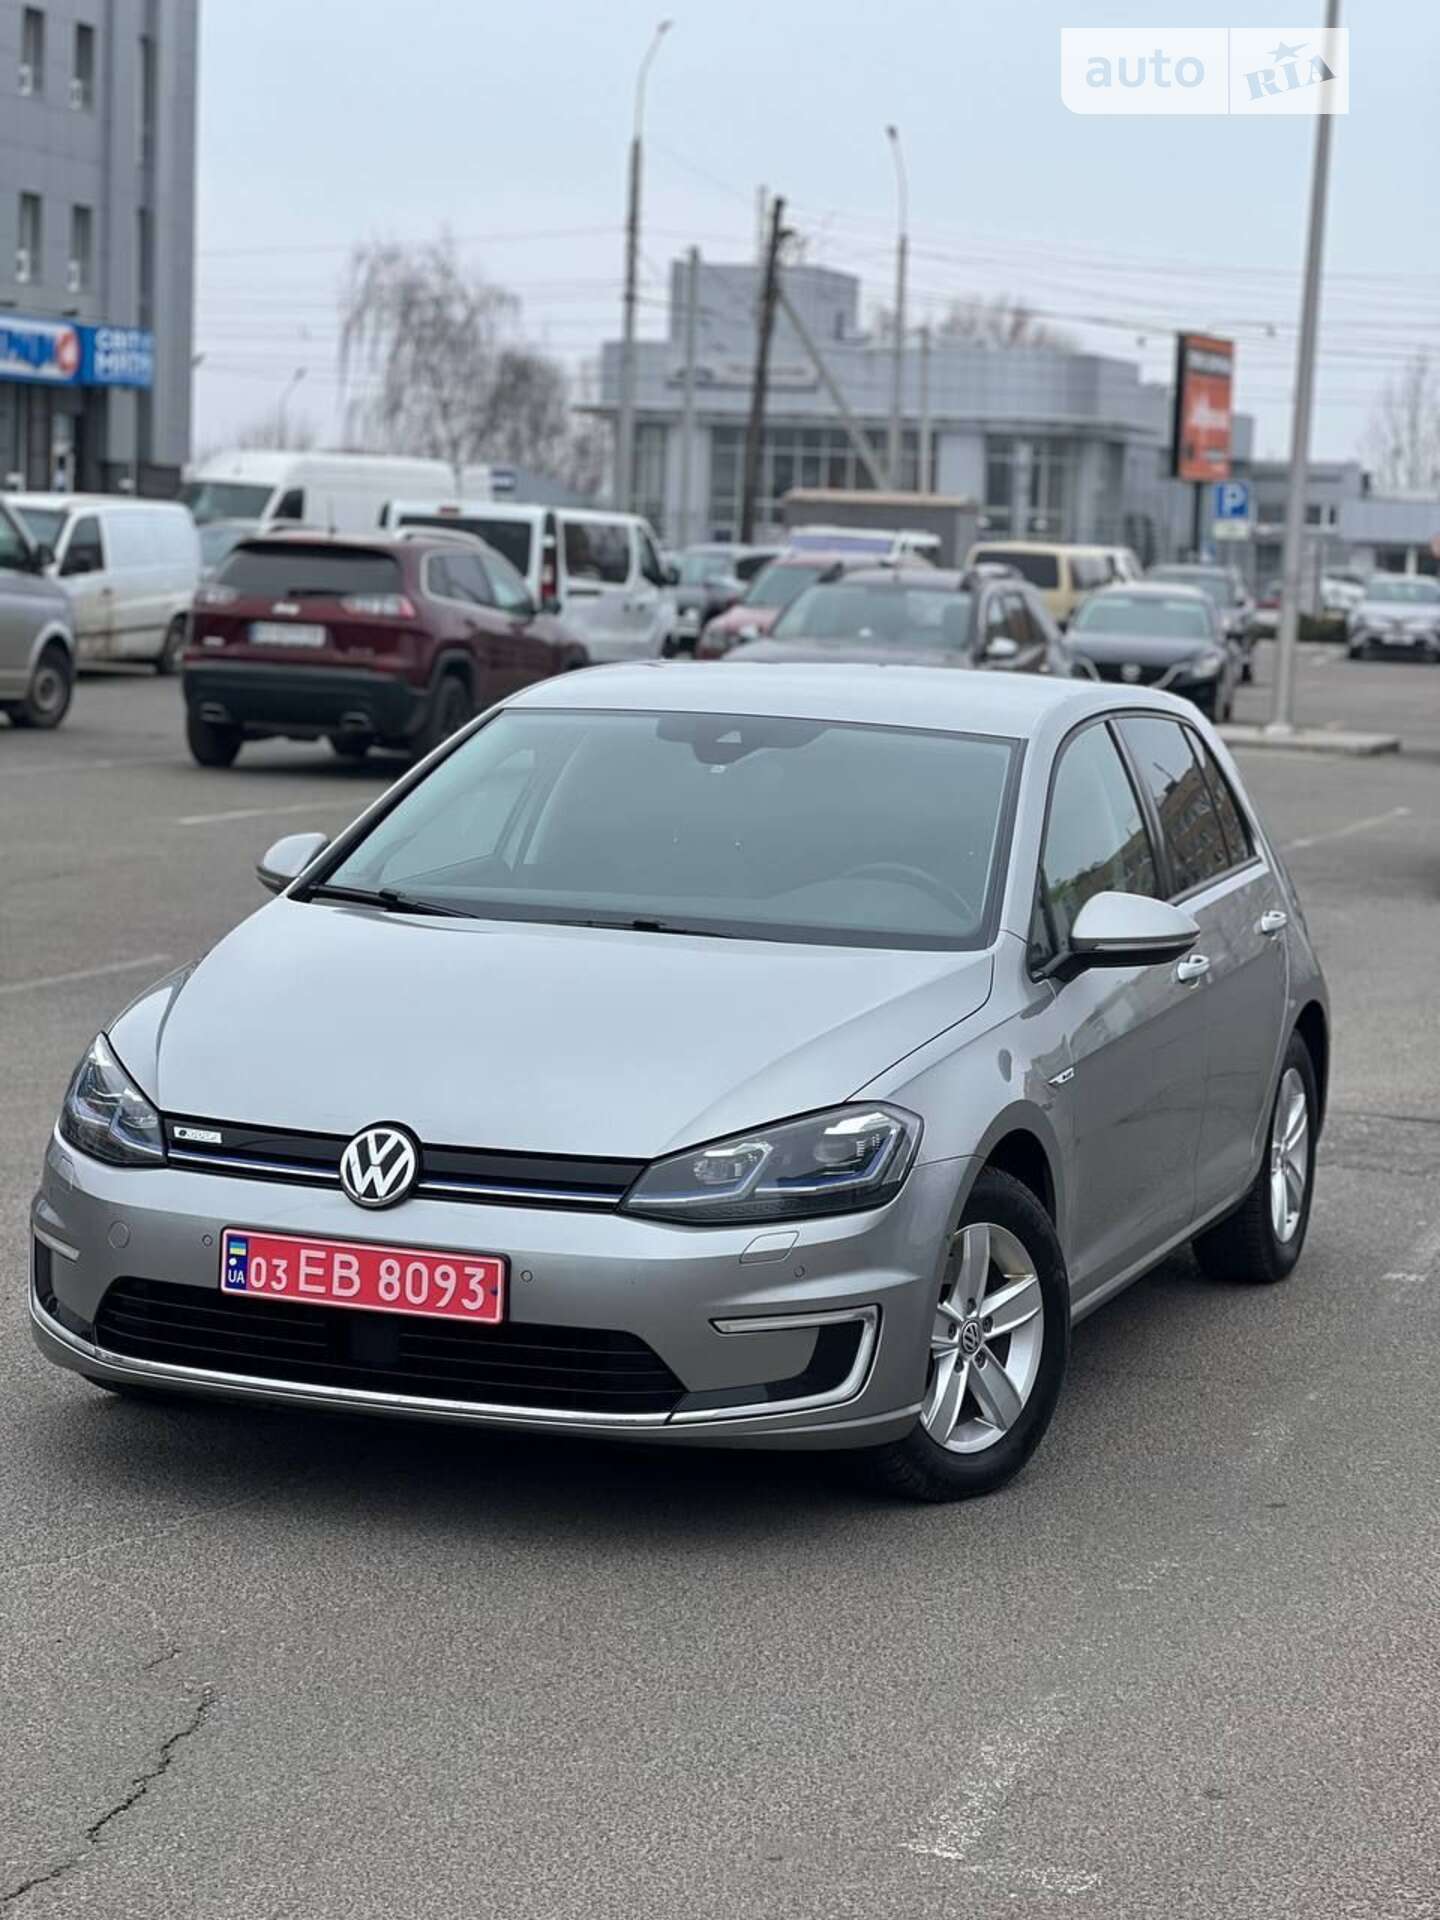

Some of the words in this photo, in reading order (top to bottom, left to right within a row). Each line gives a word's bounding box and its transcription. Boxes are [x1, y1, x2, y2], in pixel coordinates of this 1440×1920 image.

[1223, 484, 1244, 517] P
[228, 1269, 245, 1285] UA
[250, 1256, 289, 1291] 03
[298, 1248, 361, 1298] EB
[378, 1258, 485, 1311] 8093
